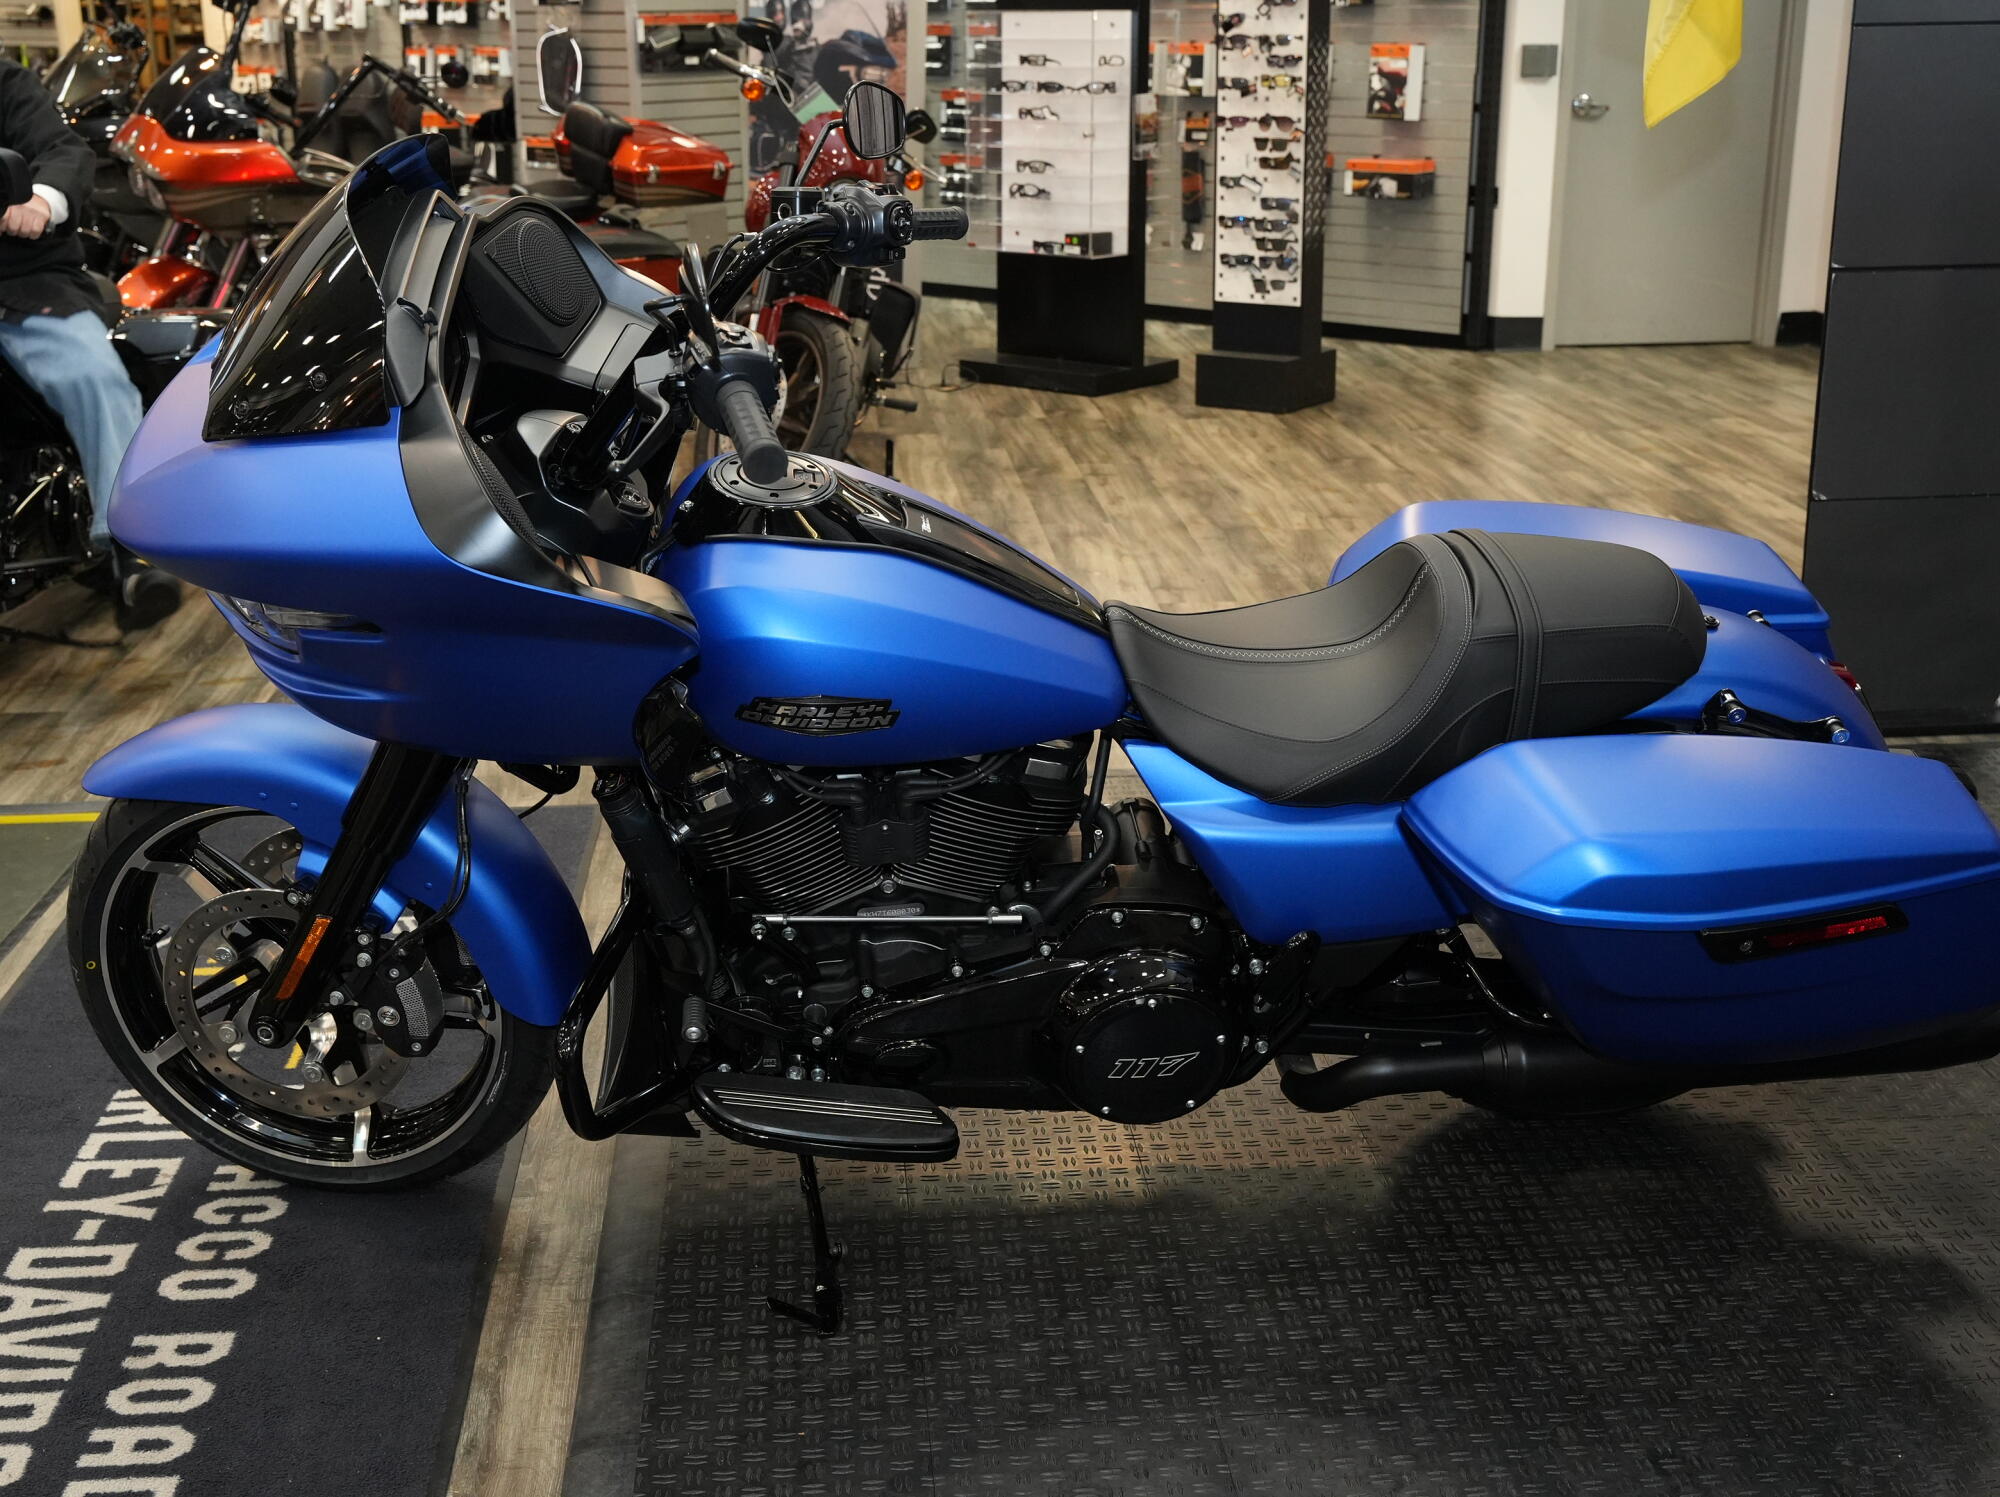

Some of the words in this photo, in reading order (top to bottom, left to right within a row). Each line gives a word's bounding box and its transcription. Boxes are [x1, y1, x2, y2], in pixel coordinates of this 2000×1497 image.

[742, 710, 893, 729] DAVIDSON
[758, 702, 885, 718] HARLEY-
[1107, 1051, 1200, 1079] 117
[158, 1165, 290, 1301] ACCO
